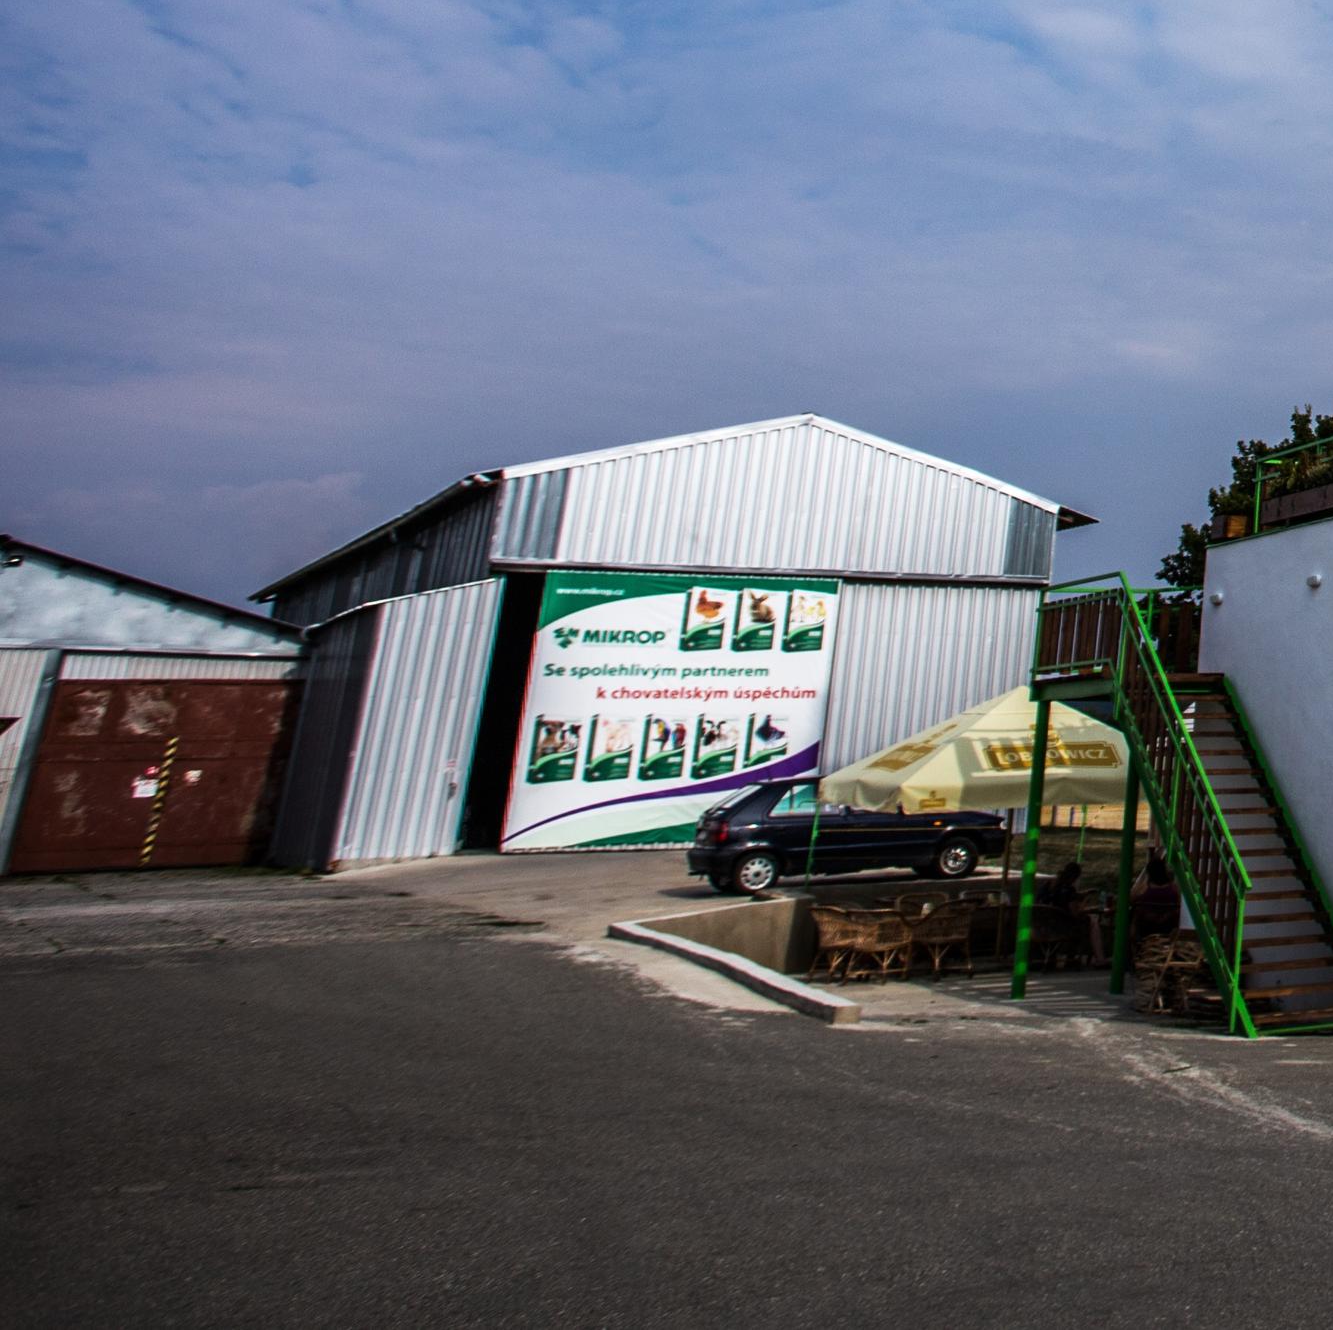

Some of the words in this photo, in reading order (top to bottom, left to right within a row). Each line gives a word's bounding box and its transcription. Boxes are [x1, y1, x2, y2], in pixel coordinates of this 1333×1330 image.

[582, 629, 666, 644] MIKROP
[543, 663, 566, 676] Se
[569, 664, 677, 680] spolehlivým
[680, 666, 770, 680] partnerem
[596, 686, 606, 700] k
[611, 686, 729, 702] chovatelským
[995, 748, 1109, 765] LOBOWICZ
